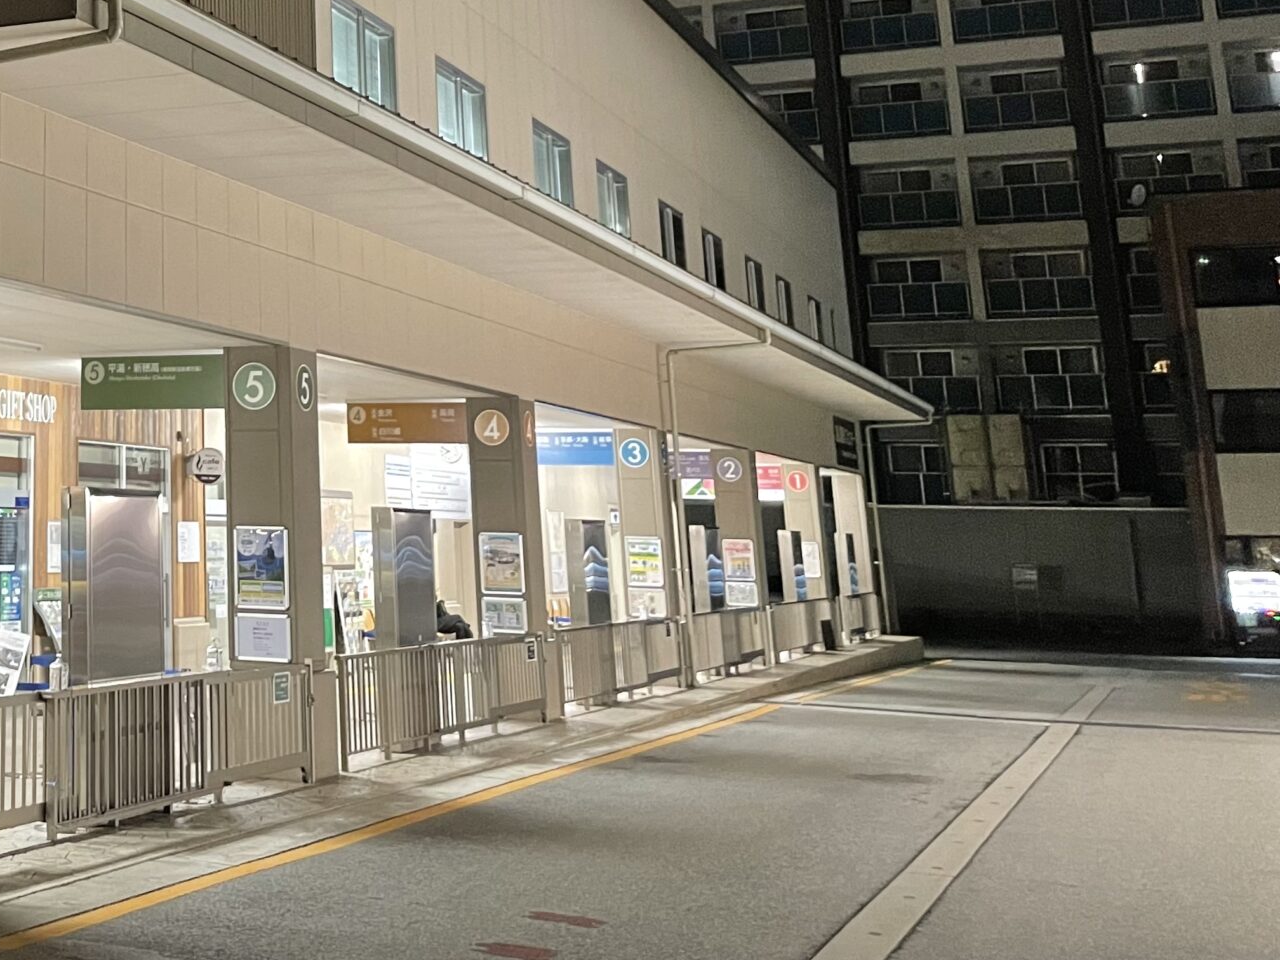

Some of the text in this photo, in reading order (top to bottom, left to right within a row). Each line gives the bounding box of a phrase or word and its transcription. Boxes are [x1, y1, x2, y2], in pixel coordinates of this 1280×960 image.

[89, 363, 99, 381] 5
[244, 370, 264, 403] 5
[301, 372, 309, 405] 5
[27, 392, 57, 423] SHOP
[483, 414, 500, 440] 4
[627, 442, 642, 464] 3
[723, 461, 737, 478] 2
